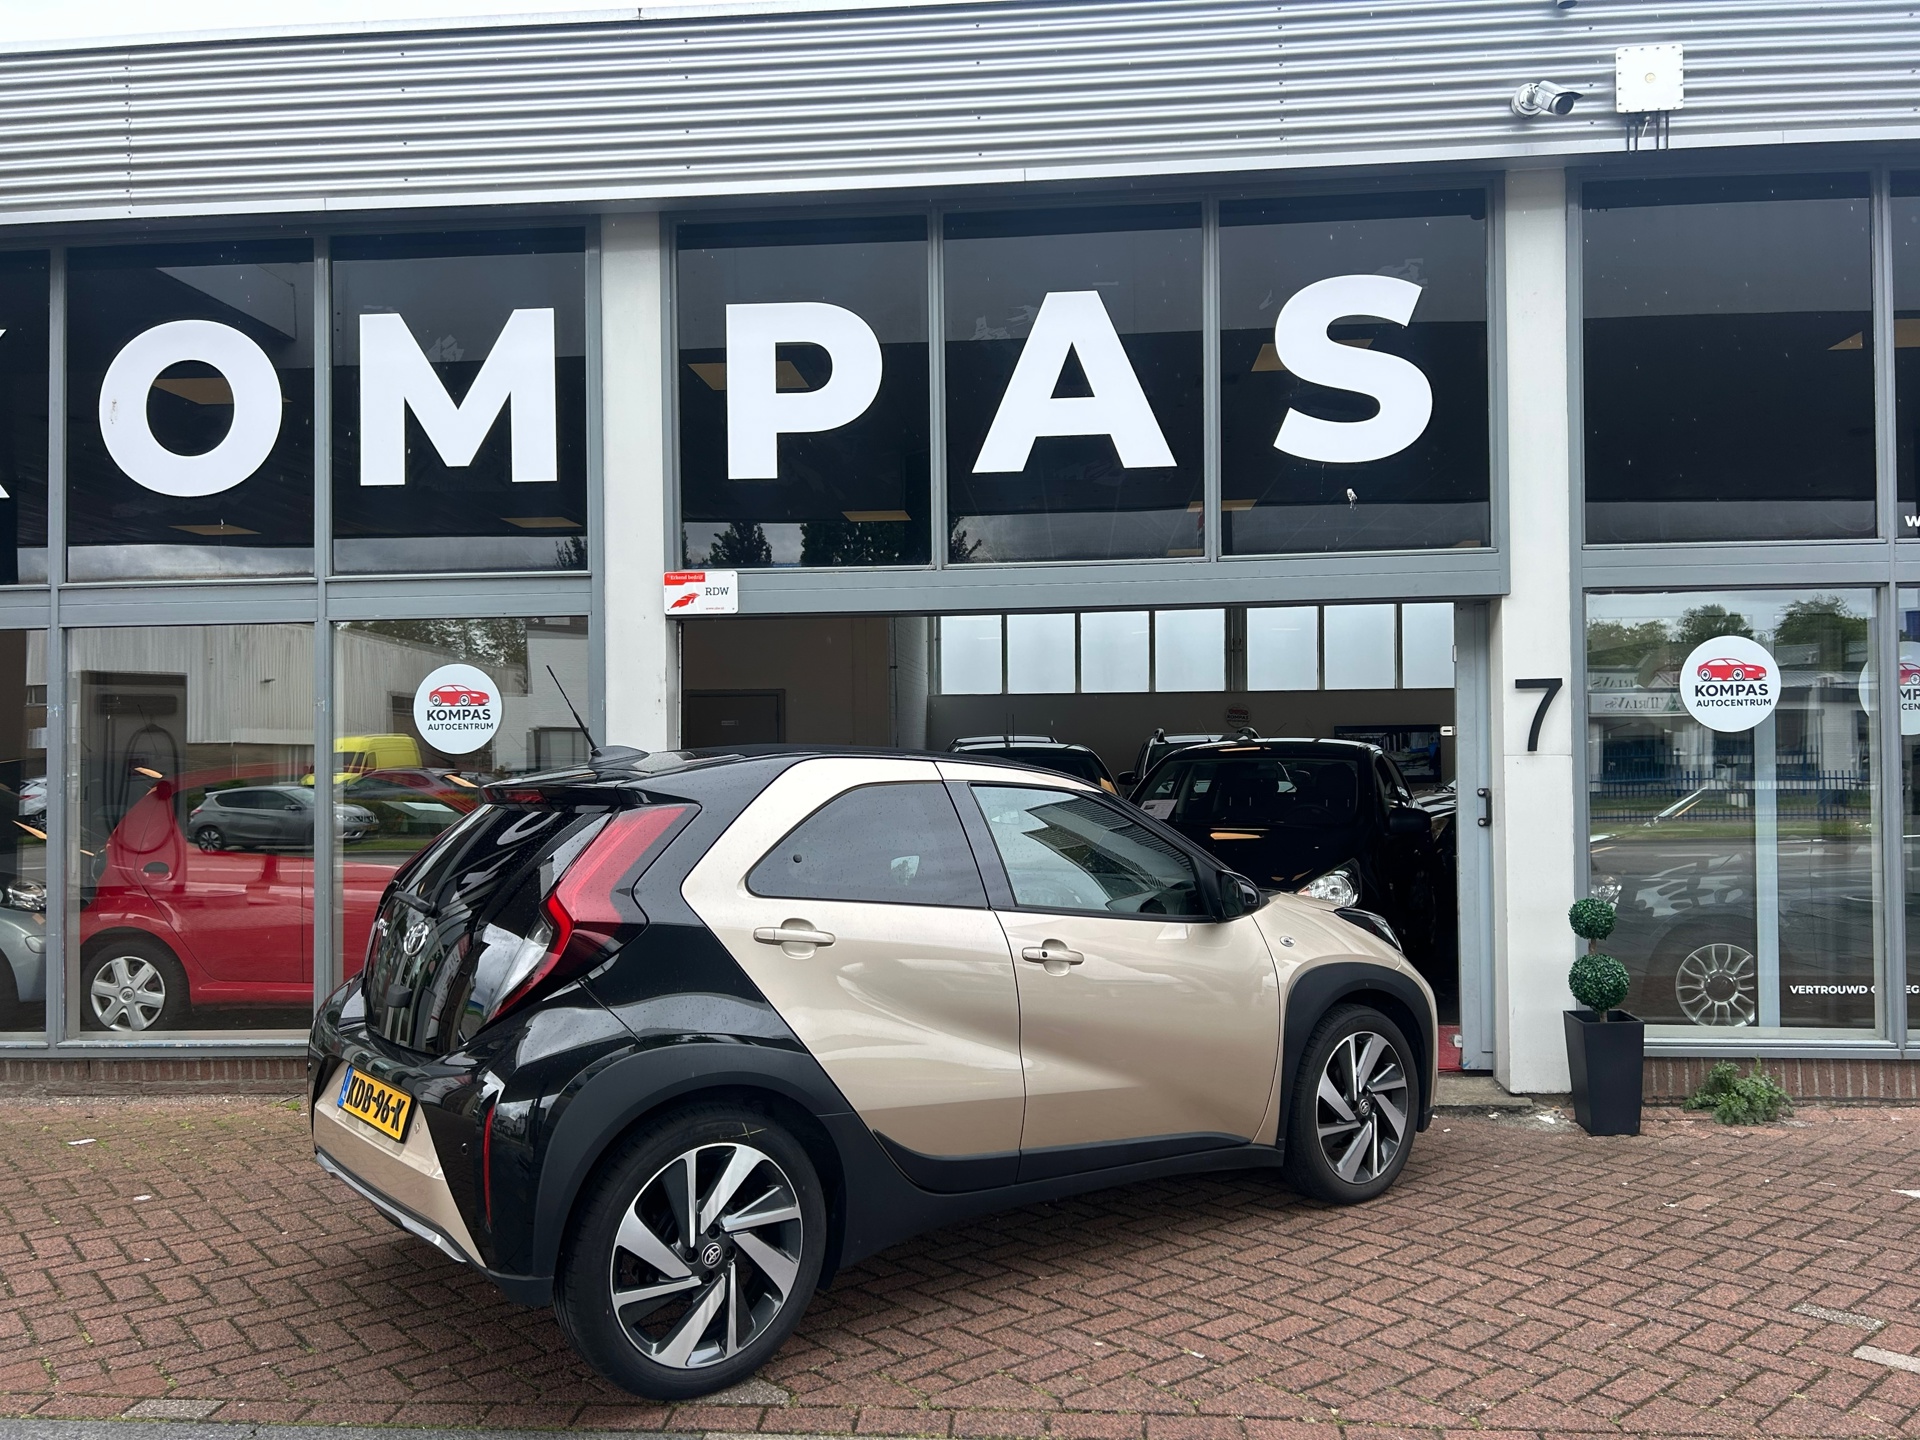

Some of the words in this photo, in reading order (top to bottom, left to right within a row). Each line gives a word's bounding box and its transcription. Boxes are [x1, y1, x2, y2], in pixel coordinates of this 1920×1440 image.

[0, 274, 1434, 499] OMPAS
[705, 587, 729, 596] RDW
[1694, 683, 1769, 698] KOMPAS
[1696, 698, 1772, 708] AUTOCENTRUM
[426, 709, 491, 721] KOMPAS
[1515, 678, 1563, 752] 7
[427, 722, 494, 731] AUTOCENTRUM
[1789, 985, 1868, 994] VERTROUWD
[346, 1075, 406, 1132] KDB-96-K
